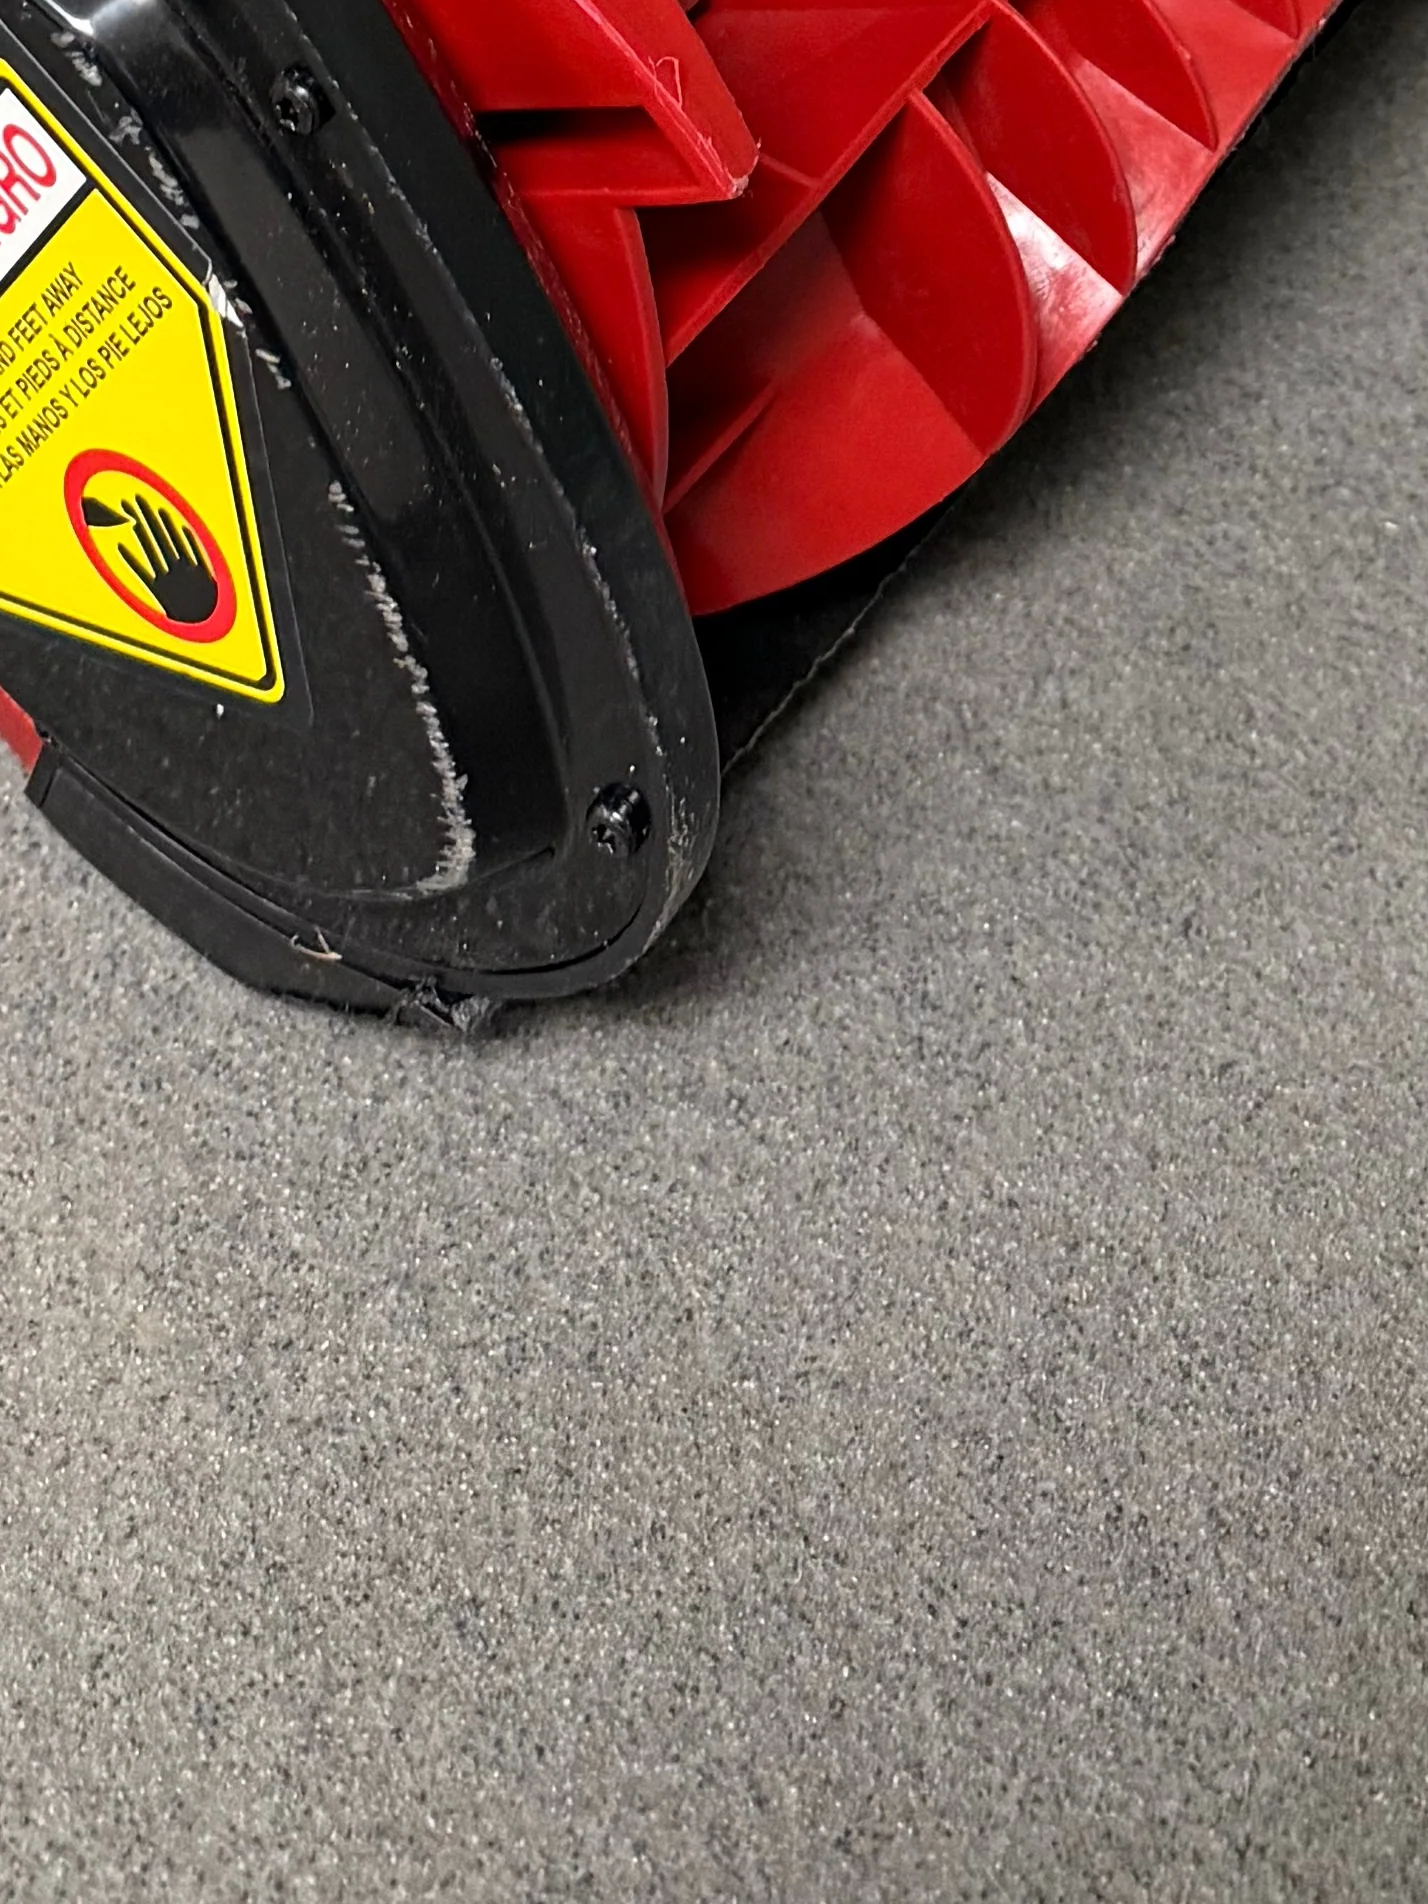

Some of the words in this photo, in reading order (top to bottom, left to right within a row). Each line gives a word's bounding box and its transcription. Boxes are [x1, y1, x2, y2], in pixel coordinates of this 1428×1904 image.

[0, 387, 25, 420] ET
[15, 349, 61, 401] PIEDS
[49, 333, 74, 361] À
[63, 265, 136, 348] DISTANCE
[7, 302, 48, 352] FEET
[41, 261, 83, 317] AWAY
[15, 398, 69, 458] MANOS
[58, 384, 79, 407] Y
[70, 358, 106, 399] LOS
[97, 332, 130, 370] PIE
[119, 286, 172, 345] LEJOS
